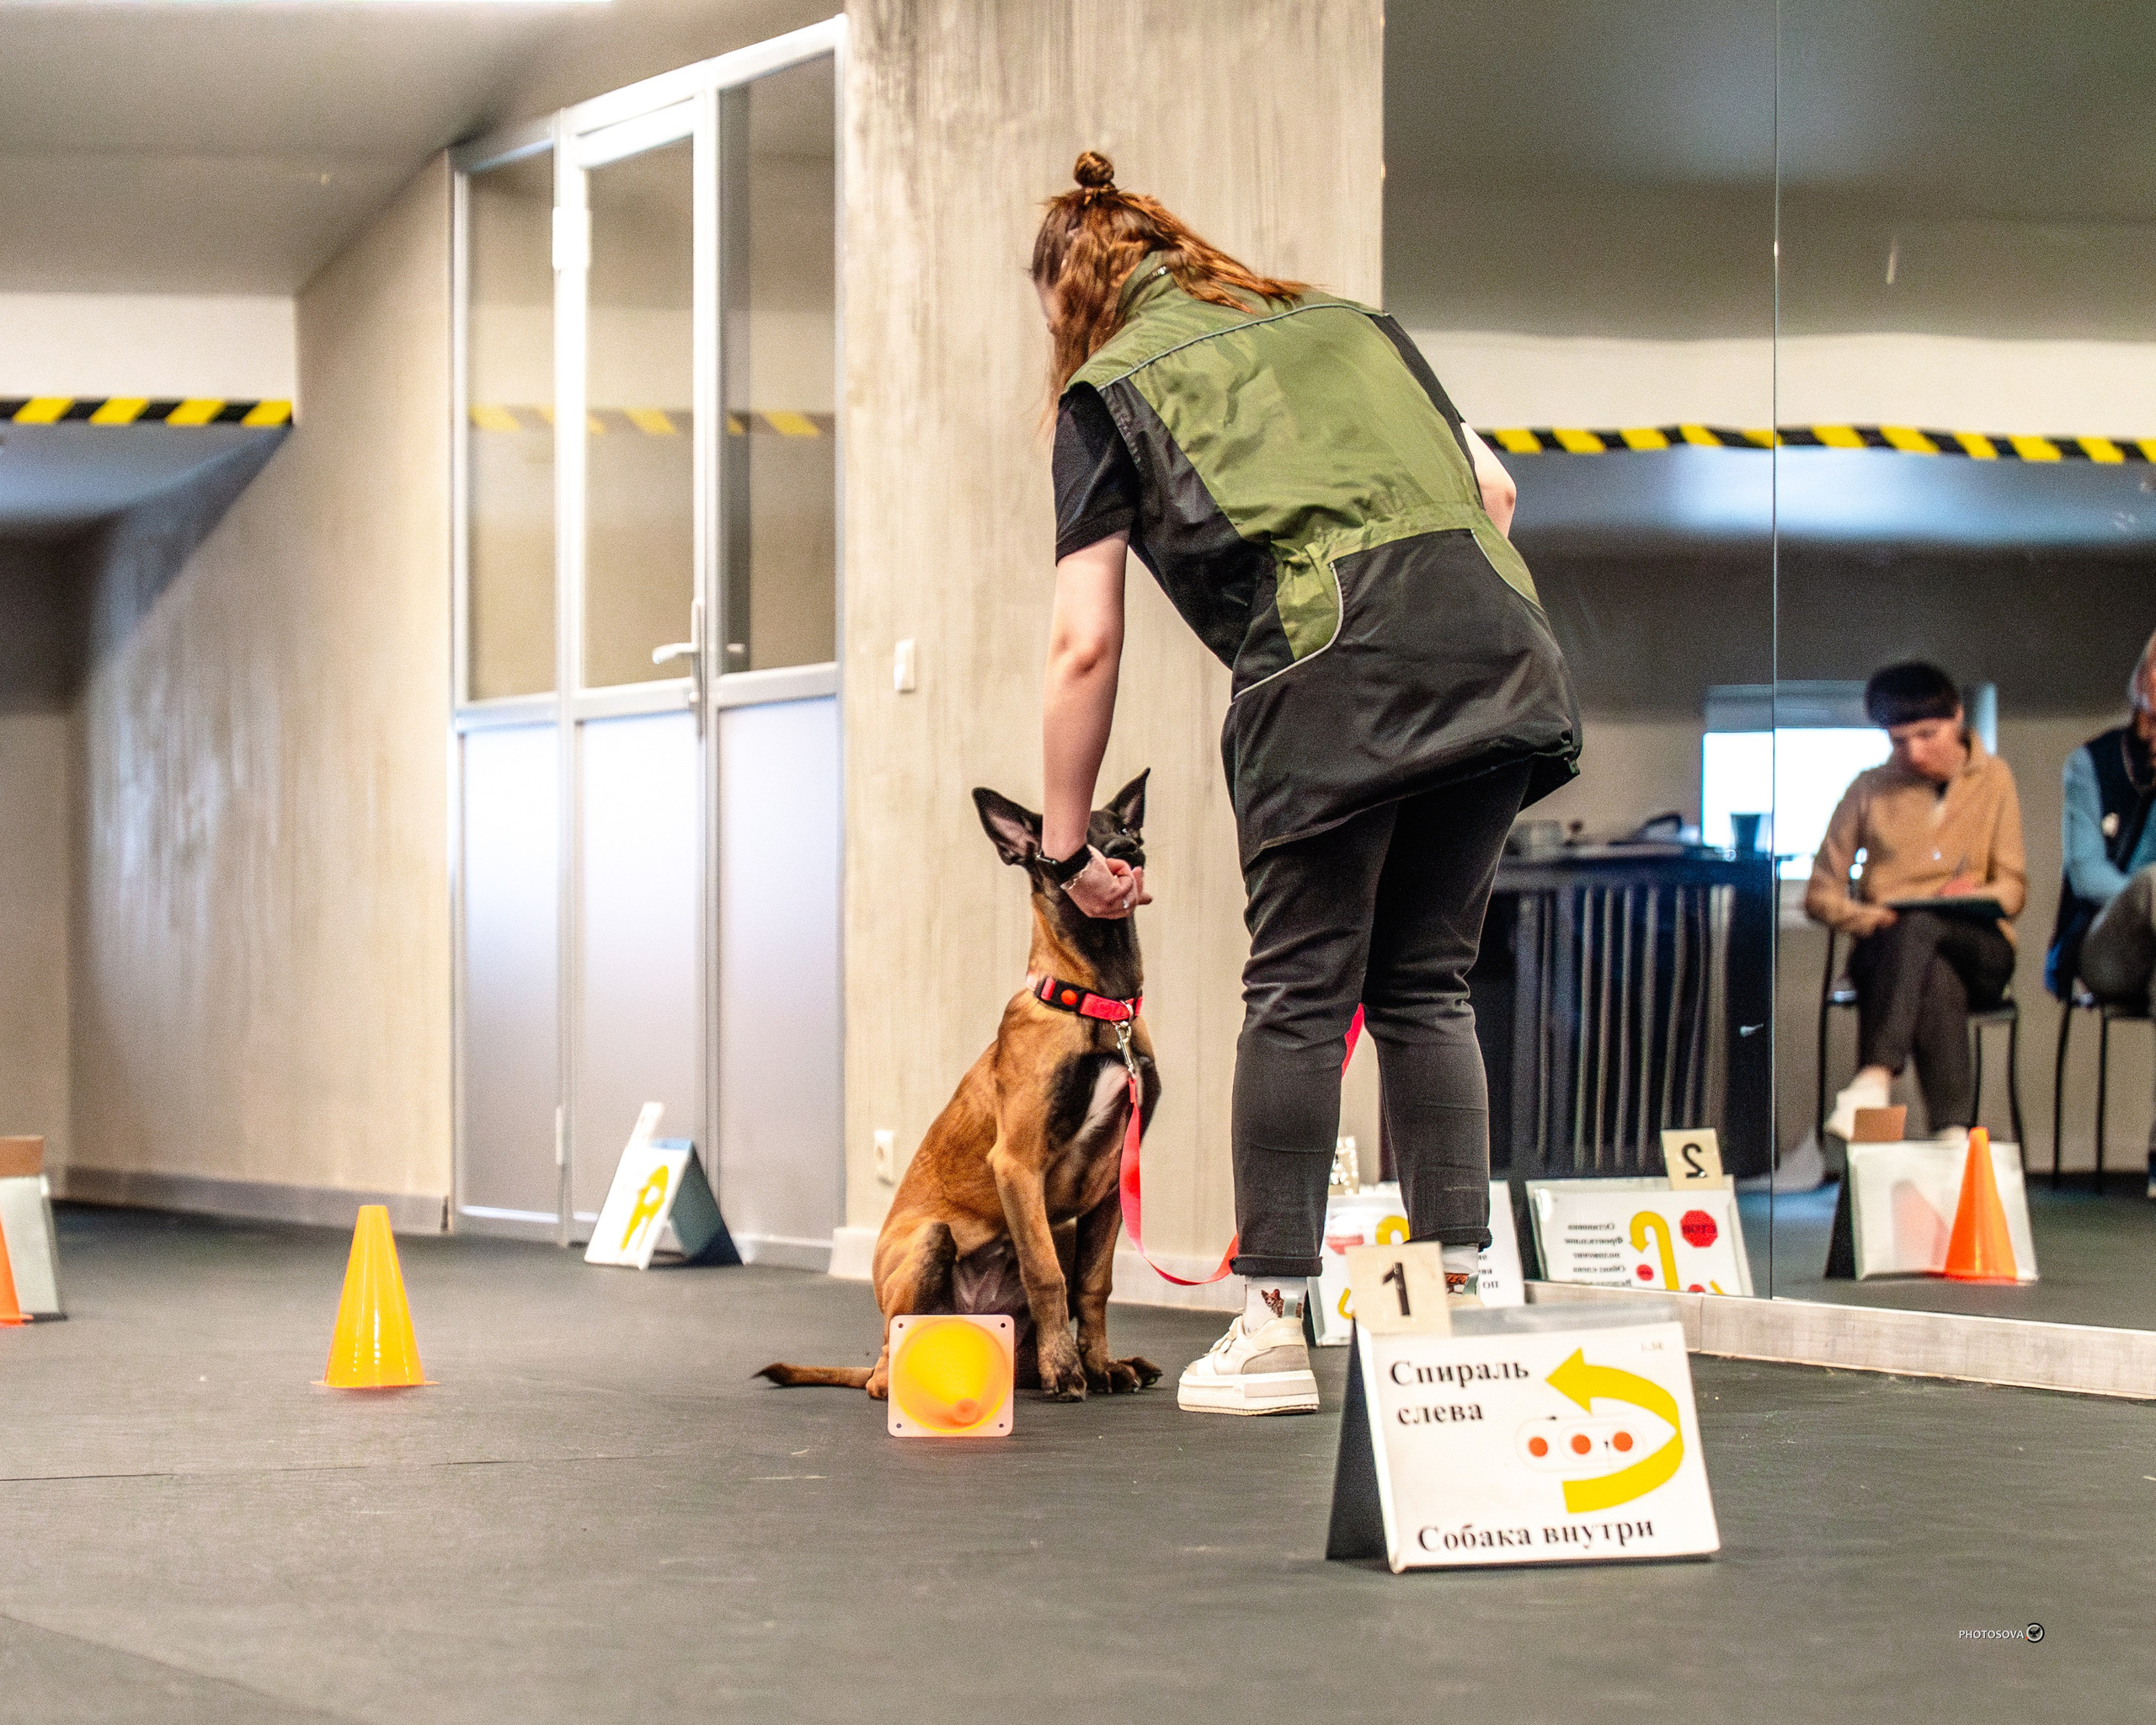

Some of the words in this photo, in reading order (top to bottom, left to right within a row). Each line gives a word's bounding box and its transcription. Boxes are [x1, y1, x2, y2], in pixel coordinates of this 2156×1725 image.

[1382, 1263, 1411, 1316] 1
[1390, 1359, 1530, 1388] Спираль
[1396, 1402, 1484, 1426] слева
[1417, 1524, 1532, 1553] Собака
[1543, 1519, 1656, 1549] внутри
